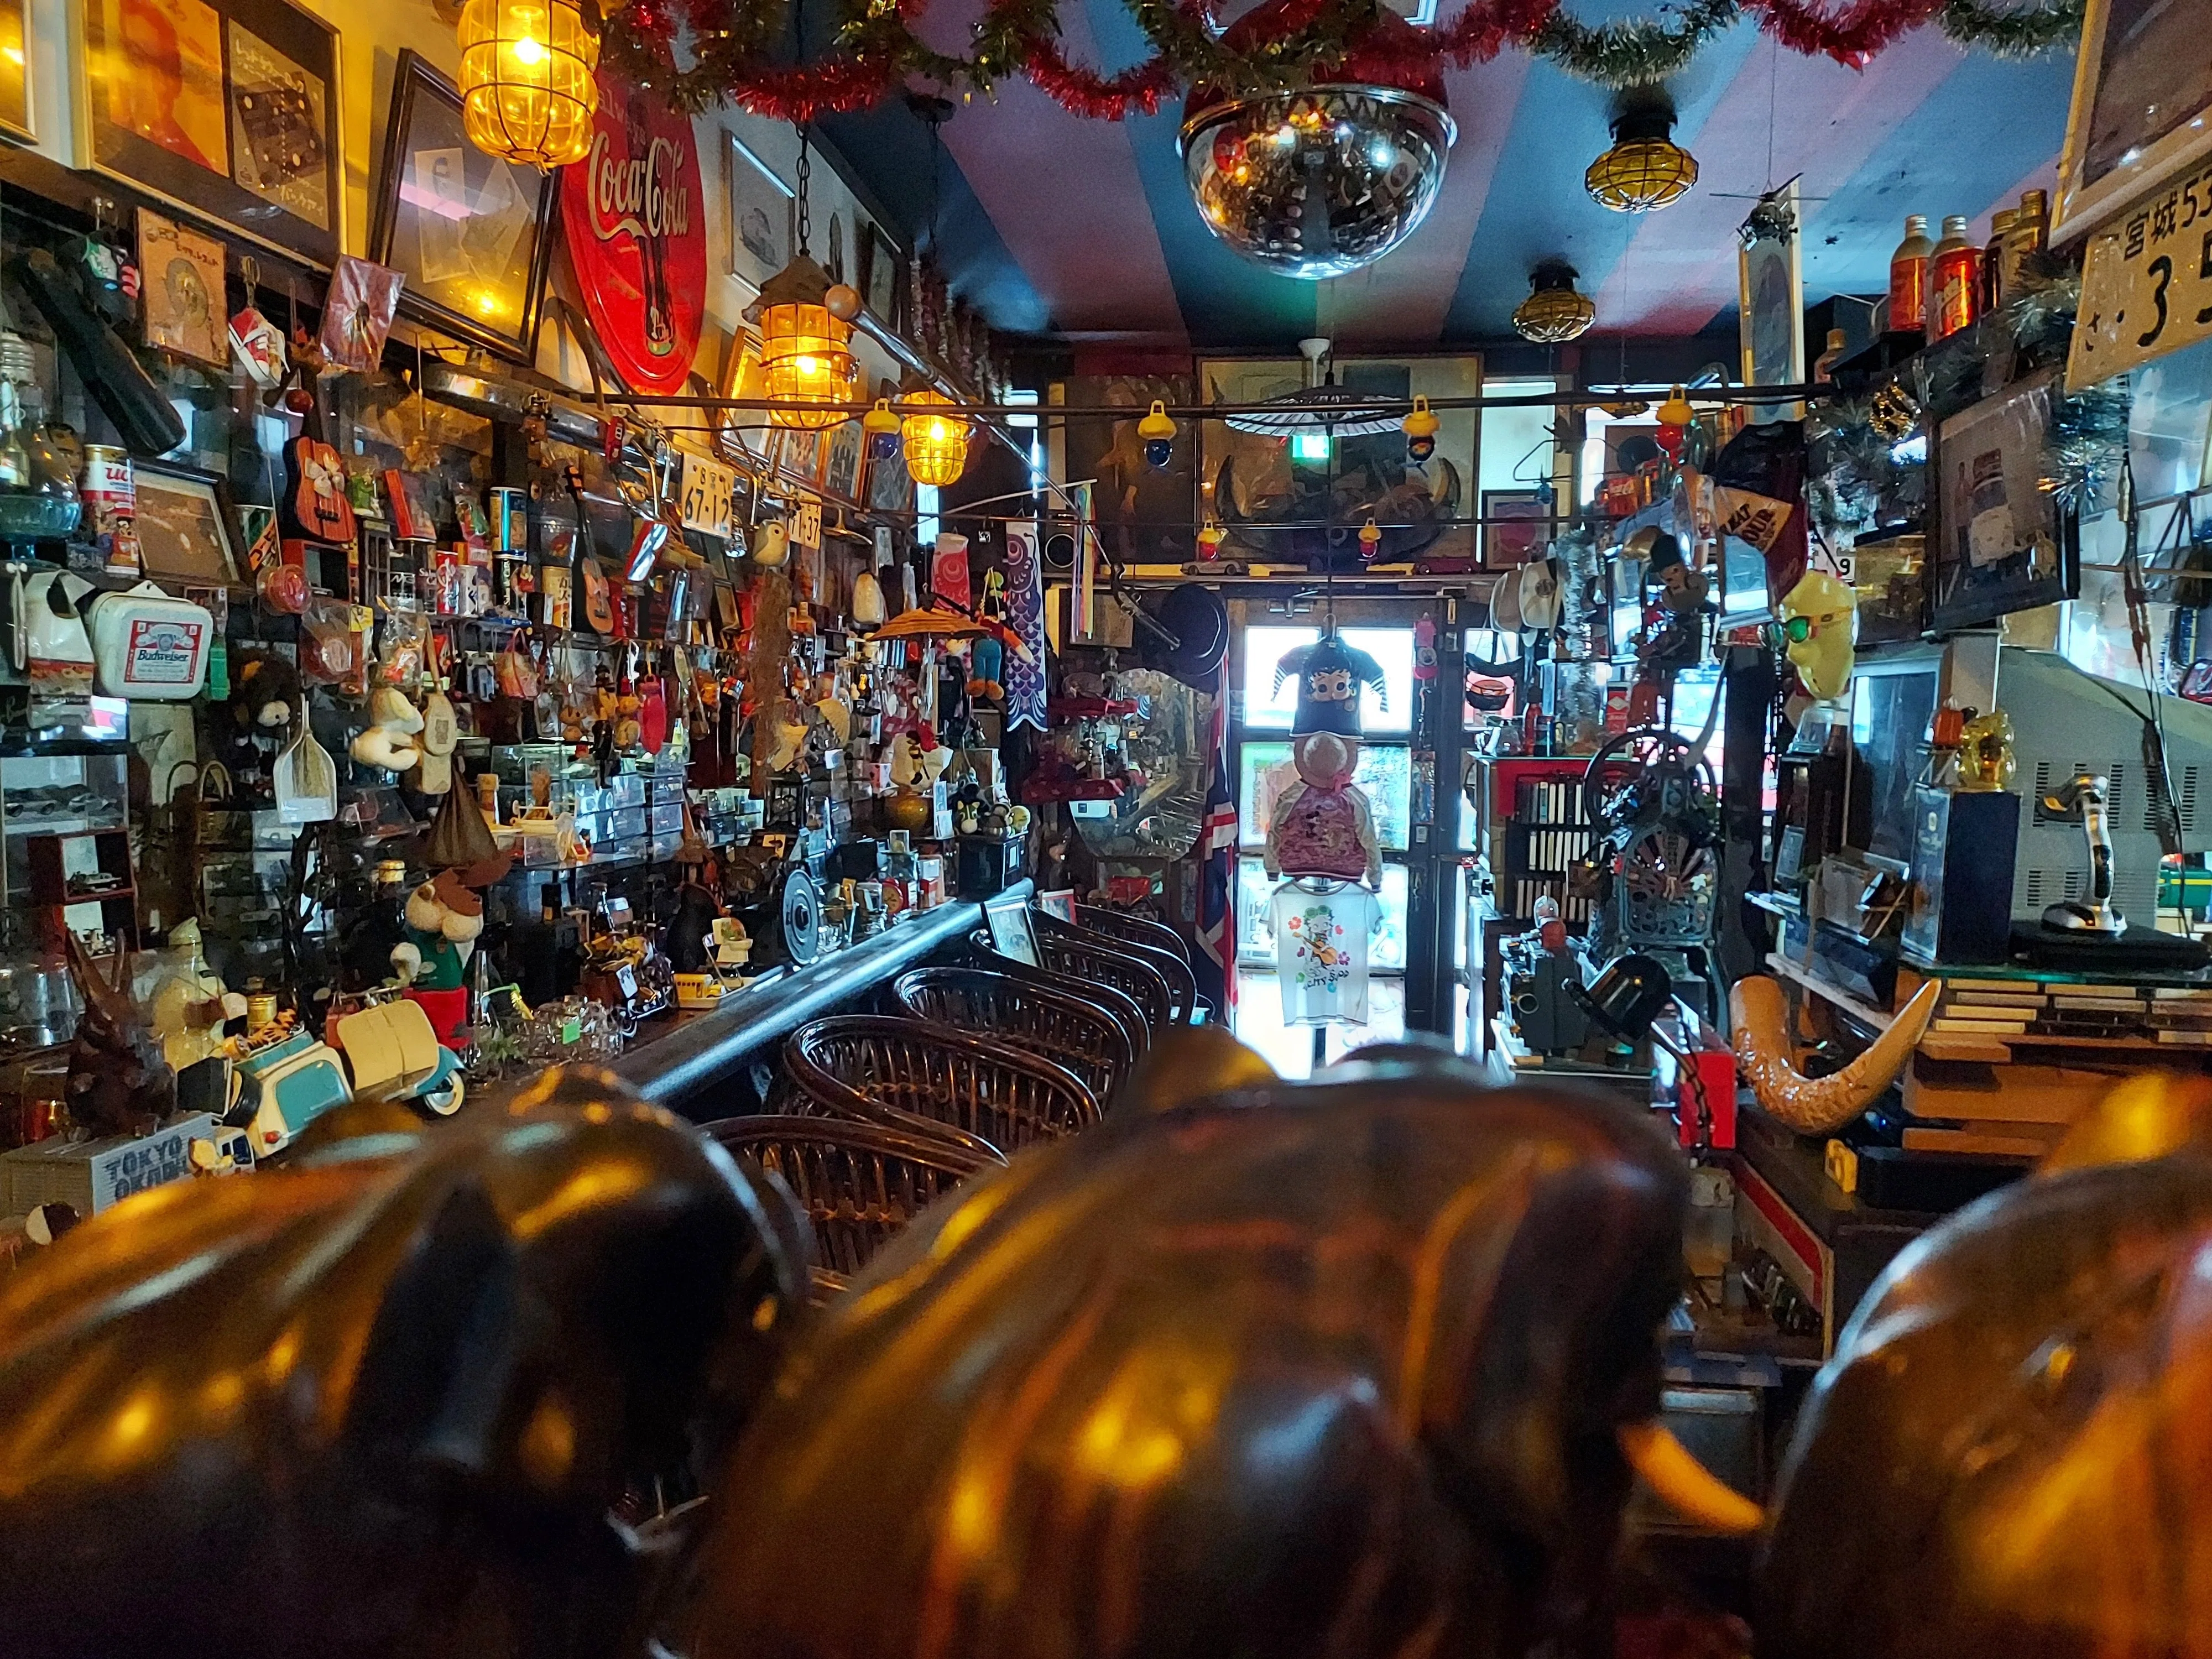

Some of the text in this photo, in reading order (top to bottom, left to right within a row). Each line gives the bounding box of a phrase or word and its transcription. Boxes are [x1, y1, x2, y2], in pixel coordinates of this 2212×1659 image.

[588, 131, 689, 240] Coca-Cola
[137, 649, 189, 662] Budweiser
[102, 1135, 182, 1182] TOKYO
